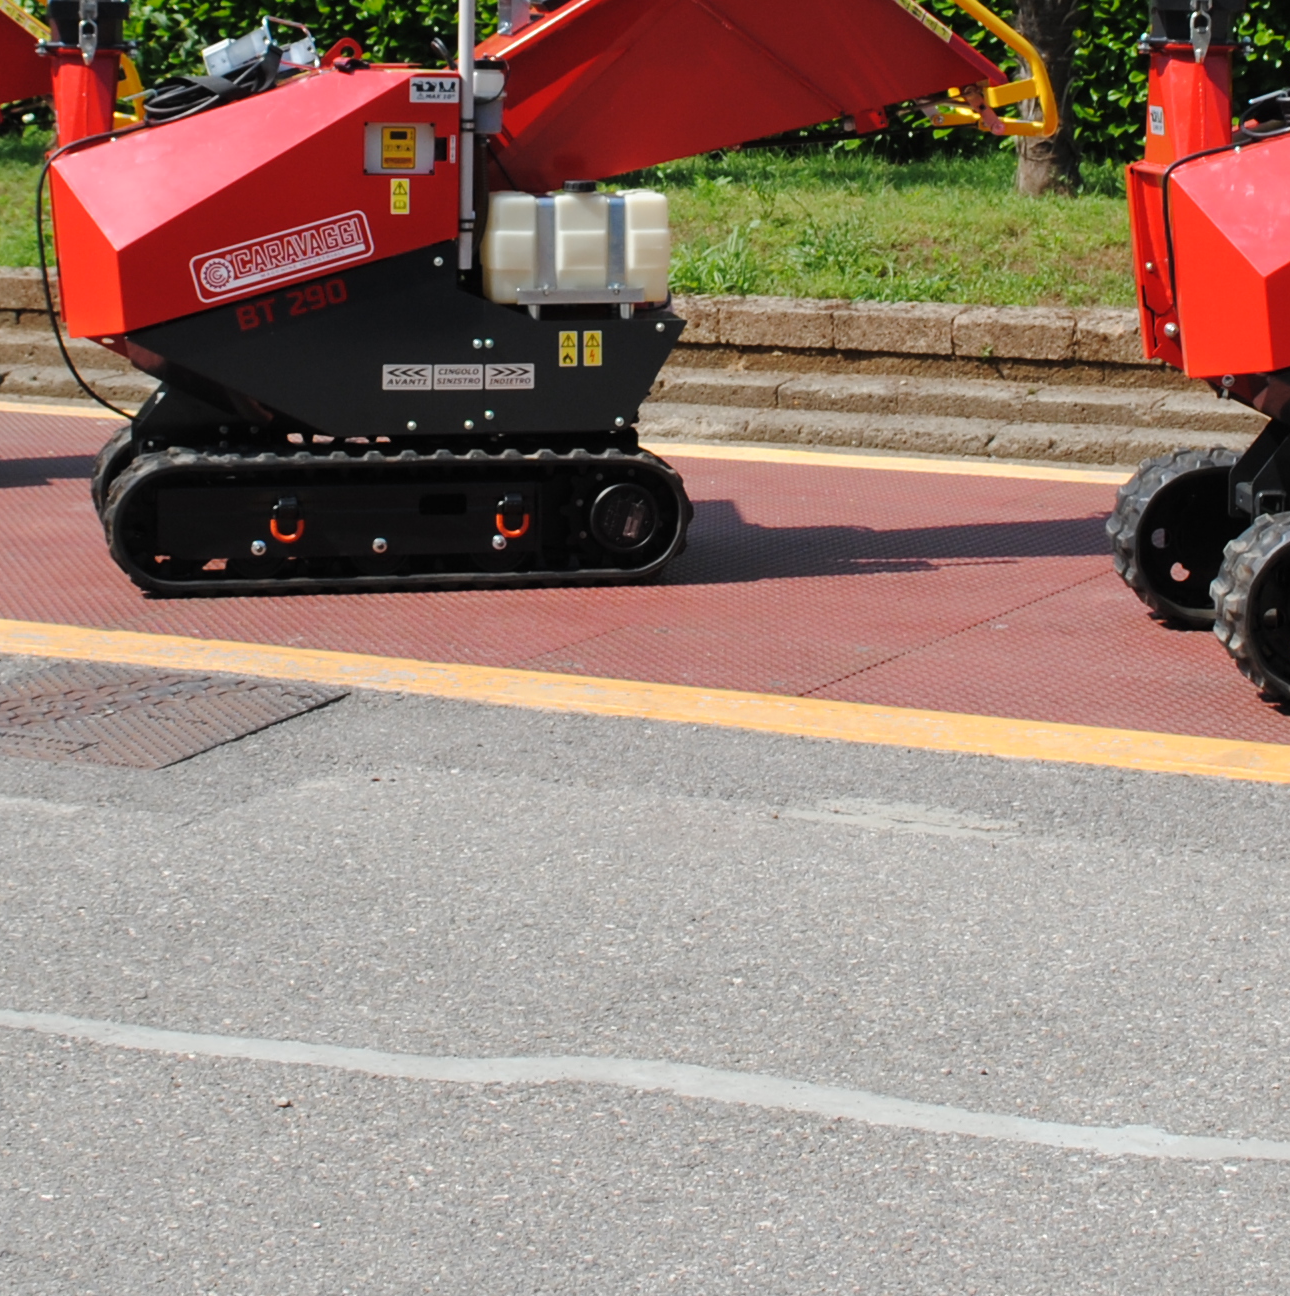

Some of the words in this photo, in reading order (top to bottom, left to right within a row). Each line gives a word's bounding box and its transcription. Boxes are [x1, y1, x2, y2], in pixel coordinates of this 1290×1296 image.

[232, 218, 364, 277] CARAVAGGI
[235, 297, 276, 332] BT
[286, 278, 349, 317] 290
[387, 378, 428, 386] AVANTI
[436, 377, 481, 385] SINISTRO
[489, 377, 531, 385] INDIETRO
